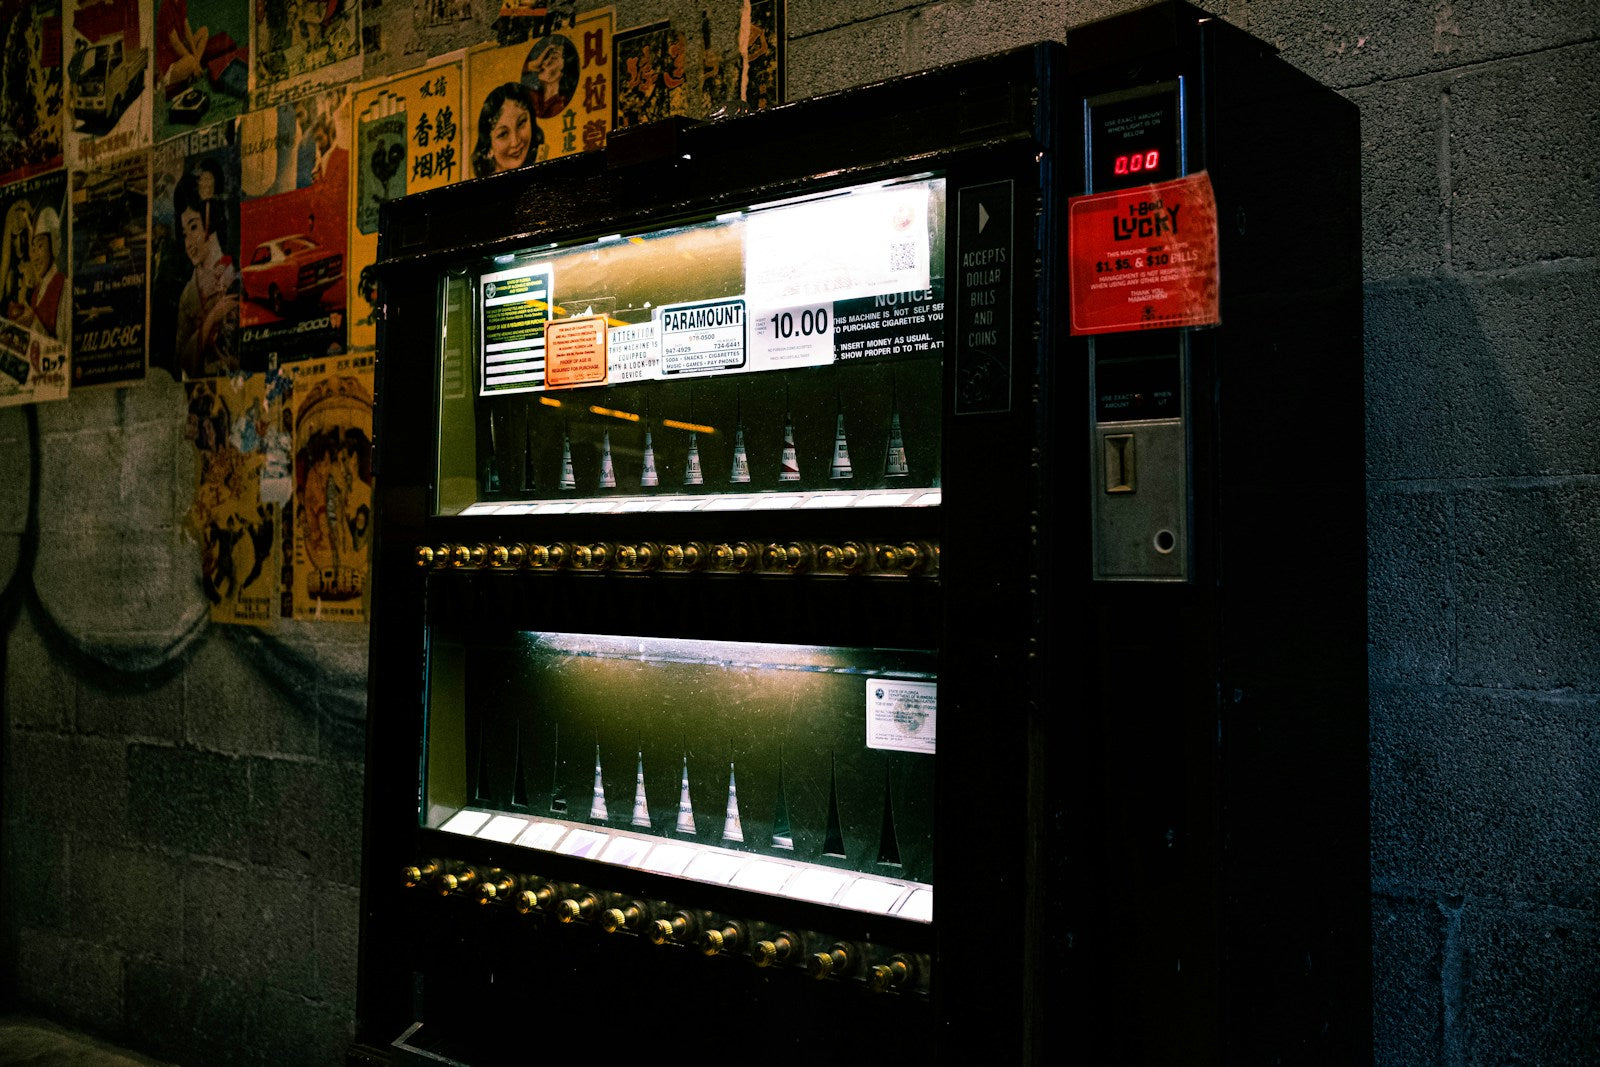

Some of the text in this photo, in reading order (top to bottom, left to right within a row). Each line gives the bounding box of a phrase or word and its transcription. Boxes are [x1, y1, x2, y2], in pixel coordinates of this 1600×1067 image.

[1107, 126, 1124, 134] WHEN
[1122, 130, 1144, 138] BELOW
[963, 247, 1006, 268] ACCEPTS
[1120, 248, 1146, 256] MACHINE
[1134, 257, 1144, 268] &
[1146, 254, 1168, 266] $10
[1170, 250, 1198, 264] BILLS
[966, 268, 1000, 288] DOLLAR
[1099, 272, 1138, 282] MANAGEMENT
[875, 288, 933, 307] NOTICE
[970, 290, 996, 306] BILLS
[664, 305, 741, 331] PARAMOUNT
[849, 314, 880, 322] MACHINE
[894, 308, 909, 316] NOT
[913, 305, 930, 314] SELF
[974, 310, 992, 326] AND
[770, 308, 828, 339] 10.00
[843, 321, 880, 332] PURCHASE
[882, 315, 925, 327] CIGARETTES
[928, 313, 944, 322] YOU
[624, 342, 649, 351] MACHINE
[841, 341, 864, 351] INSERT
[867, 338, 892, 348] MONEY
[906, 333, 933, 343] USUAL.
[968, 330, 997, 347] COINS
[841, 350, 862, 360] SHOW
[864, 347, 891, 357] PROPER
[902, 344, 912, 352] TO
[915, 342, 928, 351] THE
[630, 359, 659, 369] LOCK-OUT
[622, 370, 642, 379] DEVICE
